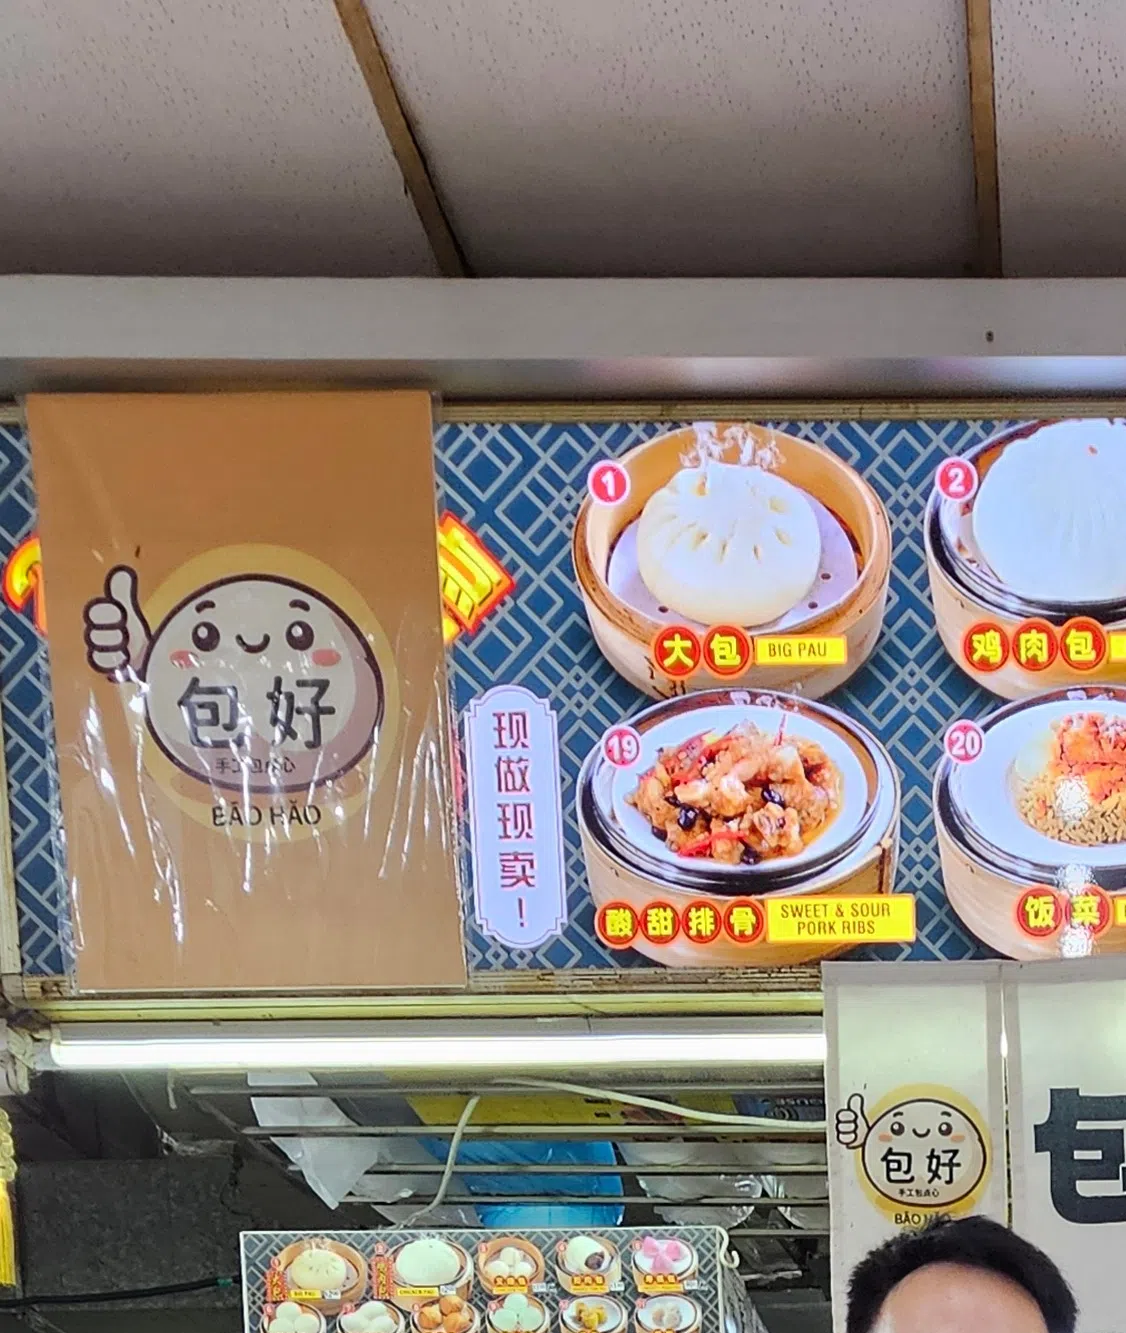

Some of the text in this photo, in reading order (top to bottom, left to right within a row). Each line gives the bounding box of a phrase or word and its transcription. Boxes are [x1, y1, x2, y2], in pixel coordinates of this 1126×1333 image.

[601, 471, 616, 497] 1
[947, 471, 967, 493] 2
[662, 633, 742, 667] 大包
[767, 641, 828, 658] BIG PAU
[970, 628, 1097, 665] 鸡肉包
[176, 675, 337, 750] 包好
[609, 734, 638, 760] 19
[950, 732, 980, 757] 20
[604, 906, 757, 937] 酸甜排骨
[780, 902, 891, 919] SWEET & SOUR
[1024, 895, 1101, 929] 饭菜
[796, 920, 876, 936] PORK RIBS
[880, 1147, 962, 1185] 包好
